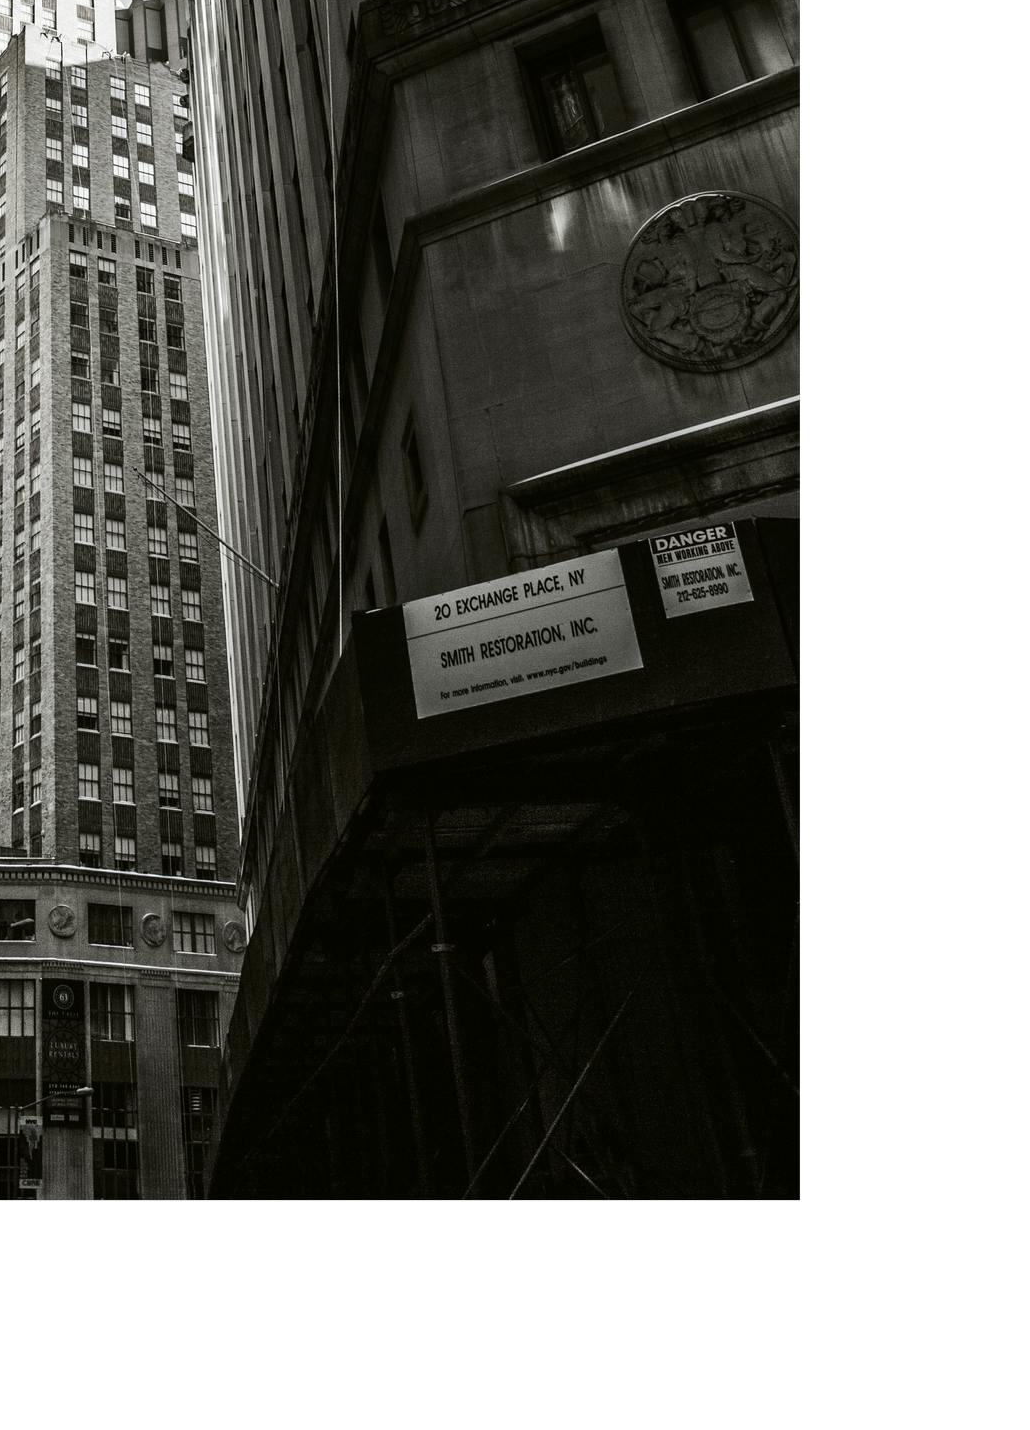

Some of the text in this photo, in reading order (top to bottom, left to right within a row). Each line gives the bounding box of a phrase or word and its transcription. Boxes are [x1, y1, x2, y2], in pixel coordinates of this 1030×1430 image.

[655, 526, 728, 551] DANGER
[656, 540, 735, 565] MEN WORKING ABOVE
[661, 574, 681, 590] SMITH
[726, 563, 742, 578] INC.
[434, 569, 585, 620] 20 EXCHANGE PLACE, NY
[676, 582, 729, 603] 212-625-8990
[440, 617, 598, 668] SMITH RESTORATION, INC.
[440, 691, 450, 699] For
[452, 688, 469, 697] more
[526, 655, 607, 680] www.nyc.gov/buildings
